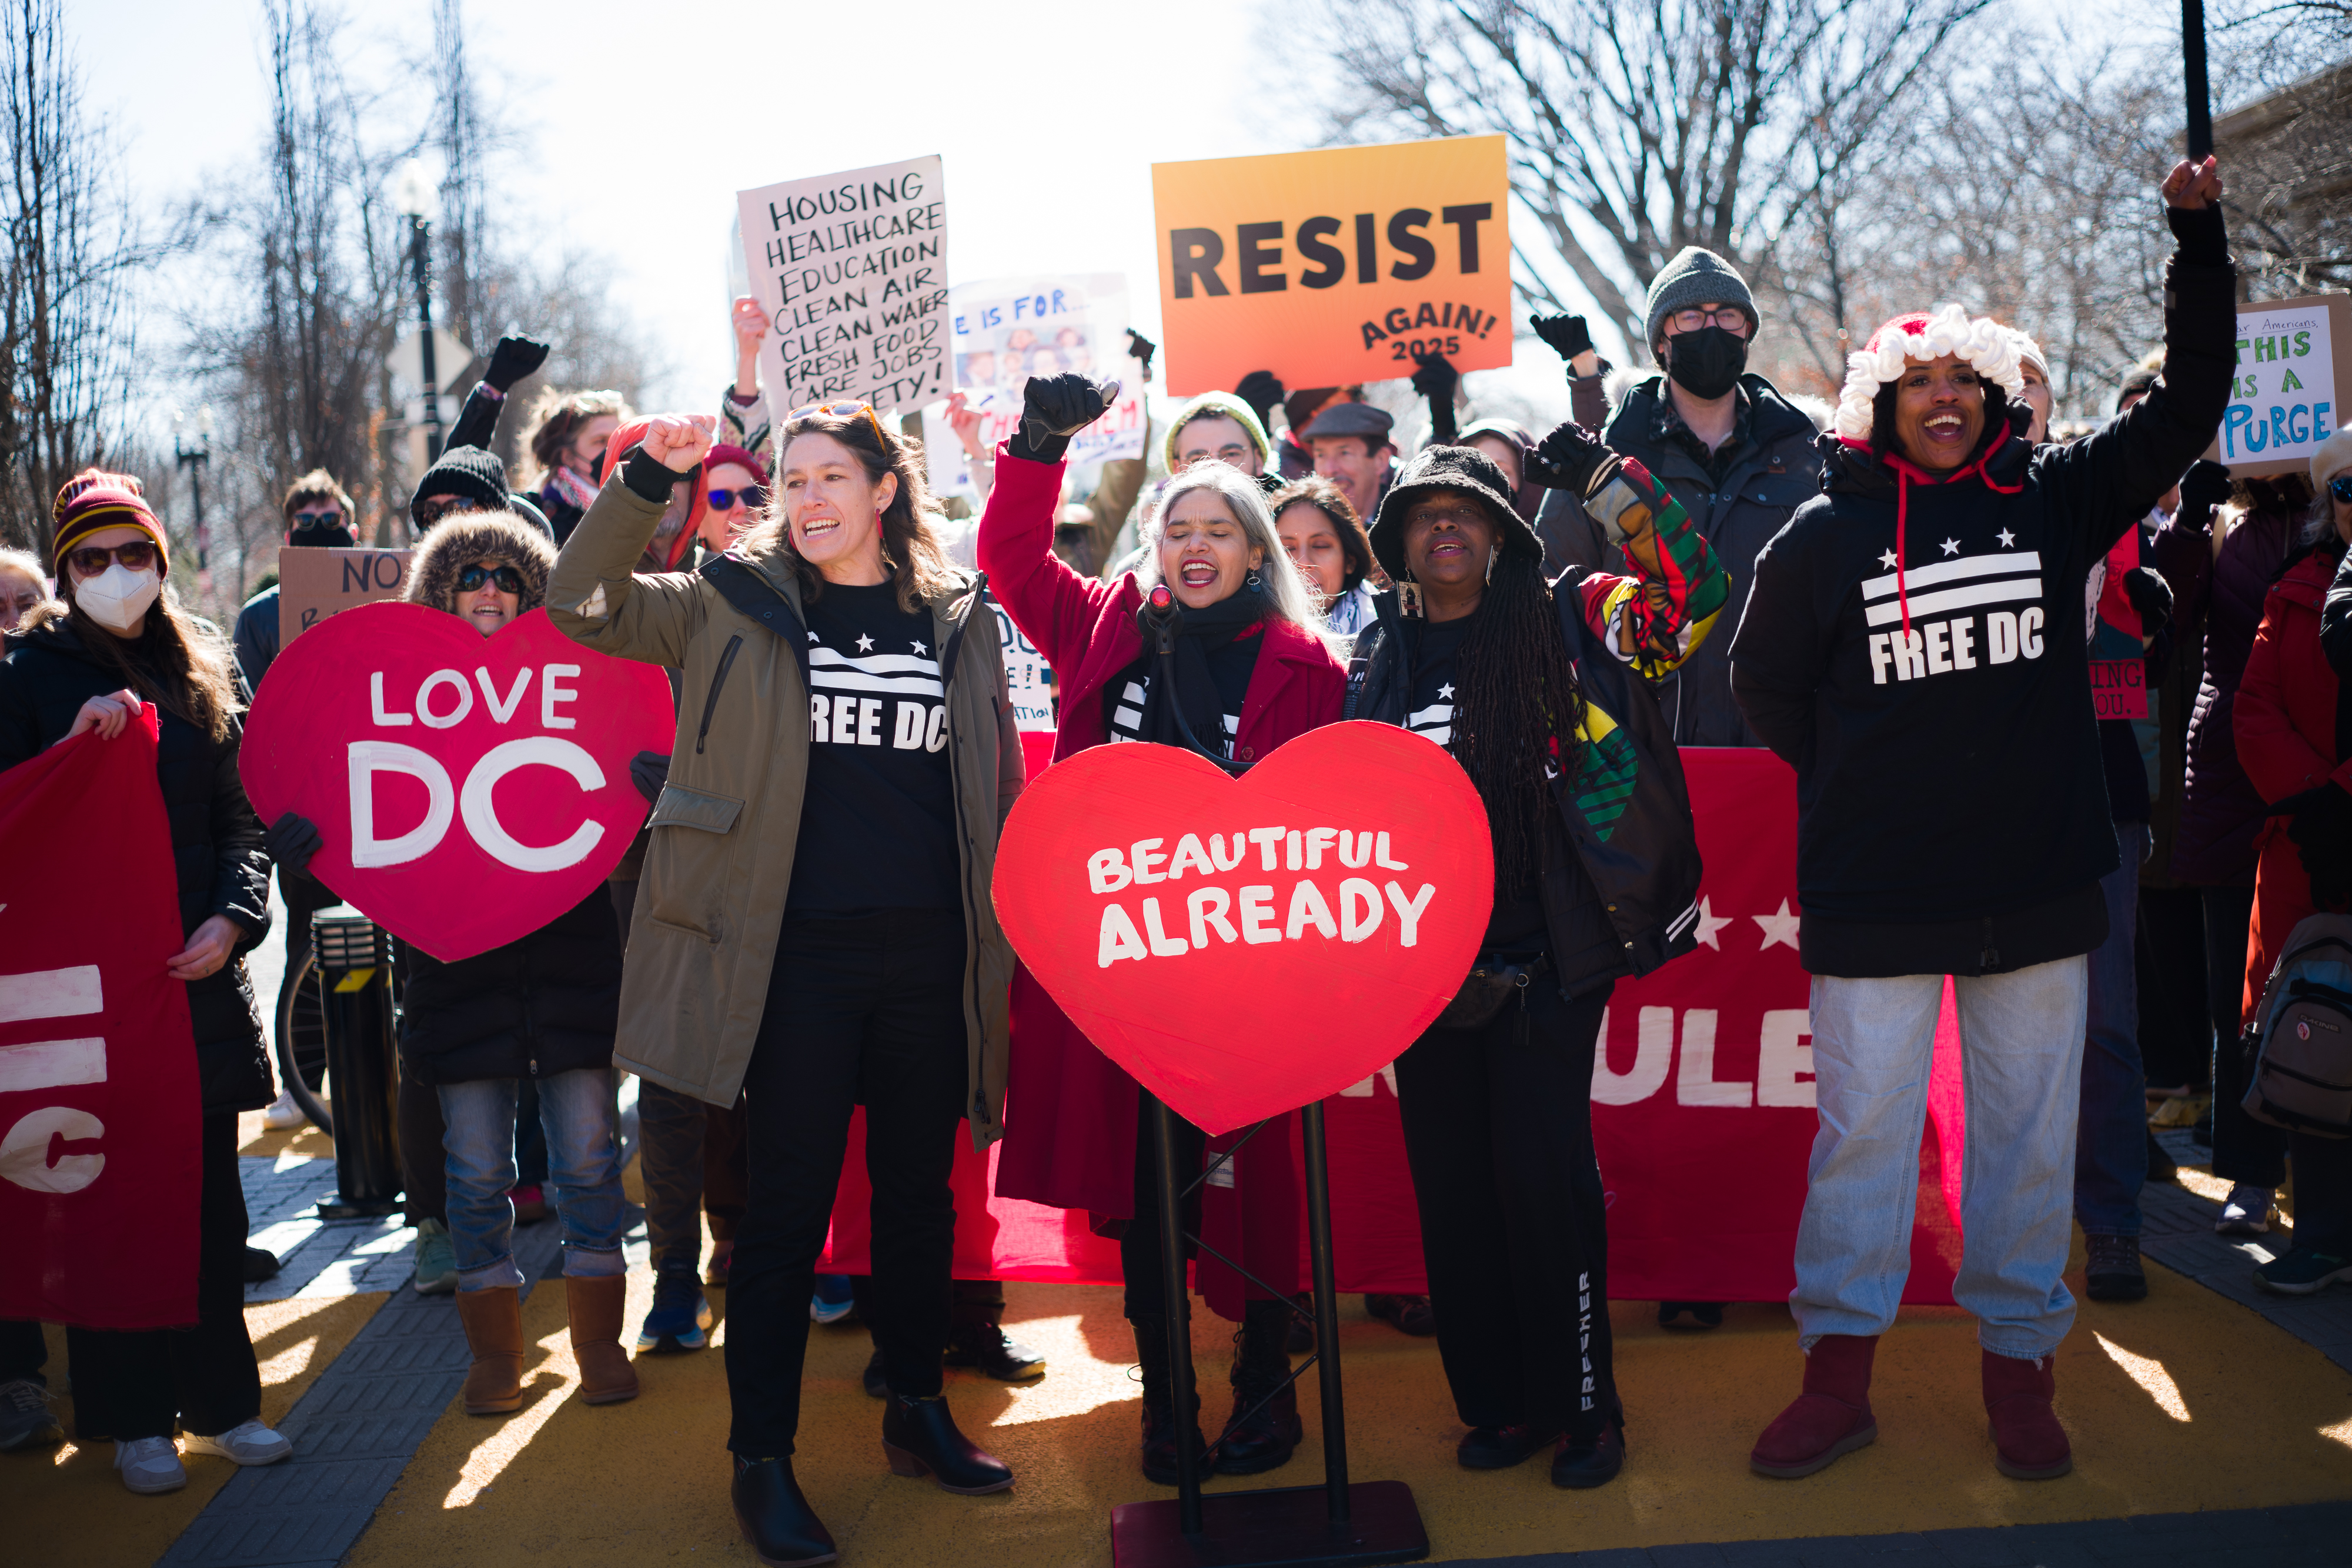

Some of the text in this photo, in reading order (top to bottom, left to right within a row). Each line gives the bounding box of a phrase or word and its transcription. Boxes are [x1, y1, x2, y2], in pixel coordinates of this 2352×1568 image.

[769, 173, 923, 231] HOUSING
[766, 202, 943, 268] HEALTHCARE
[1170, 202, 1492, 299] RESIST
[779, 236, 938, 305] EDUCATION
[774, 268, 938, 336] CLEAN AIR
[781, 289, 948, 362] CLEAN WATER
[982, 307, 1001, 329] IS
[1361, 302, 1497, 351] AGAIN!
[2263, 319, 2318, 330] Americans,
[784, 319, 938, 389] FRESH FOOD
[789, 338, 942, 410] CARE JOBS
[1392, 336, 1460, 360] 2025
[2235, 331, 2311, 365] THIS
[2233, 368, 2304, 400] IS A
[2224, 402, 2331, 459] PURGE
[342, 553, 402, 593] NO
[1869, 607, 2044, 684] FREE DC
[2089, 662, 2142, 688] ING
[370, 663, 581, 729] LOVE
[893, 701, 948, 753] DC
[2096, 694, 2132, 716] OU.
[347, 736, 606, 873] DC
[1087, 825, 1409, 894] BEAUTIFUL
[1097, 877, 1436, 968] ALREADY
